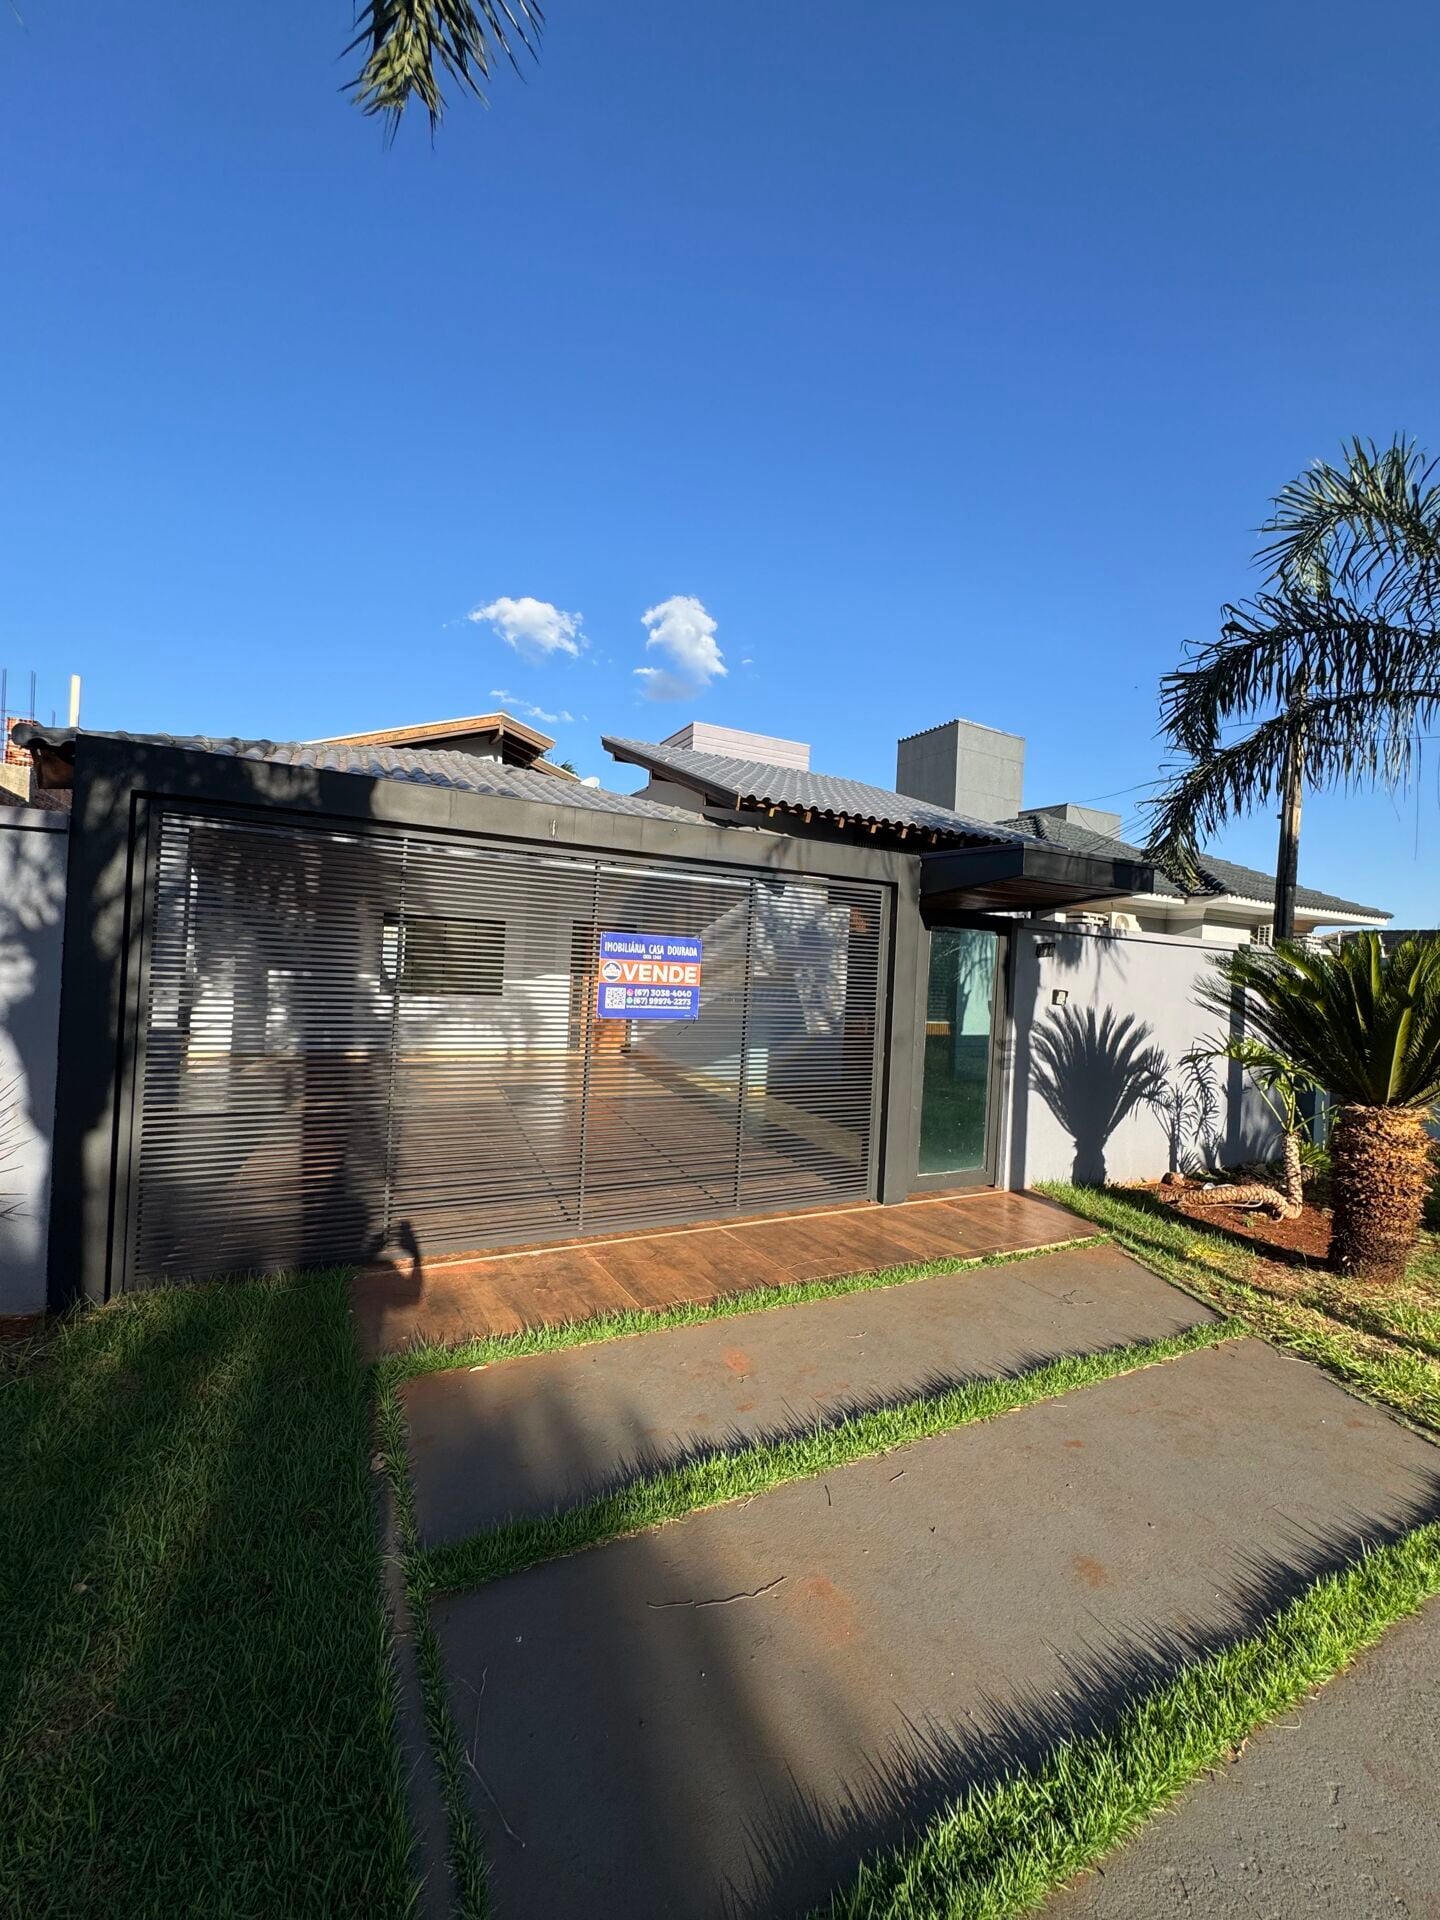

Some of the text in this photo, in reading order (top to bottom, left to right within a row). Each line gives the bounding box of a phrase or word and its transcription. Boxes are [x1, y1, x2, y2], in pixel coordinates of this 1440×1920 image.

[604, 941, 698, 957] IMOBILIÁRIA CASA DOURADA
[622, 963, 697, 984] VENDE
[634, 988, 650, 997] (67)
[633, 997, 648, 1005] (67)
